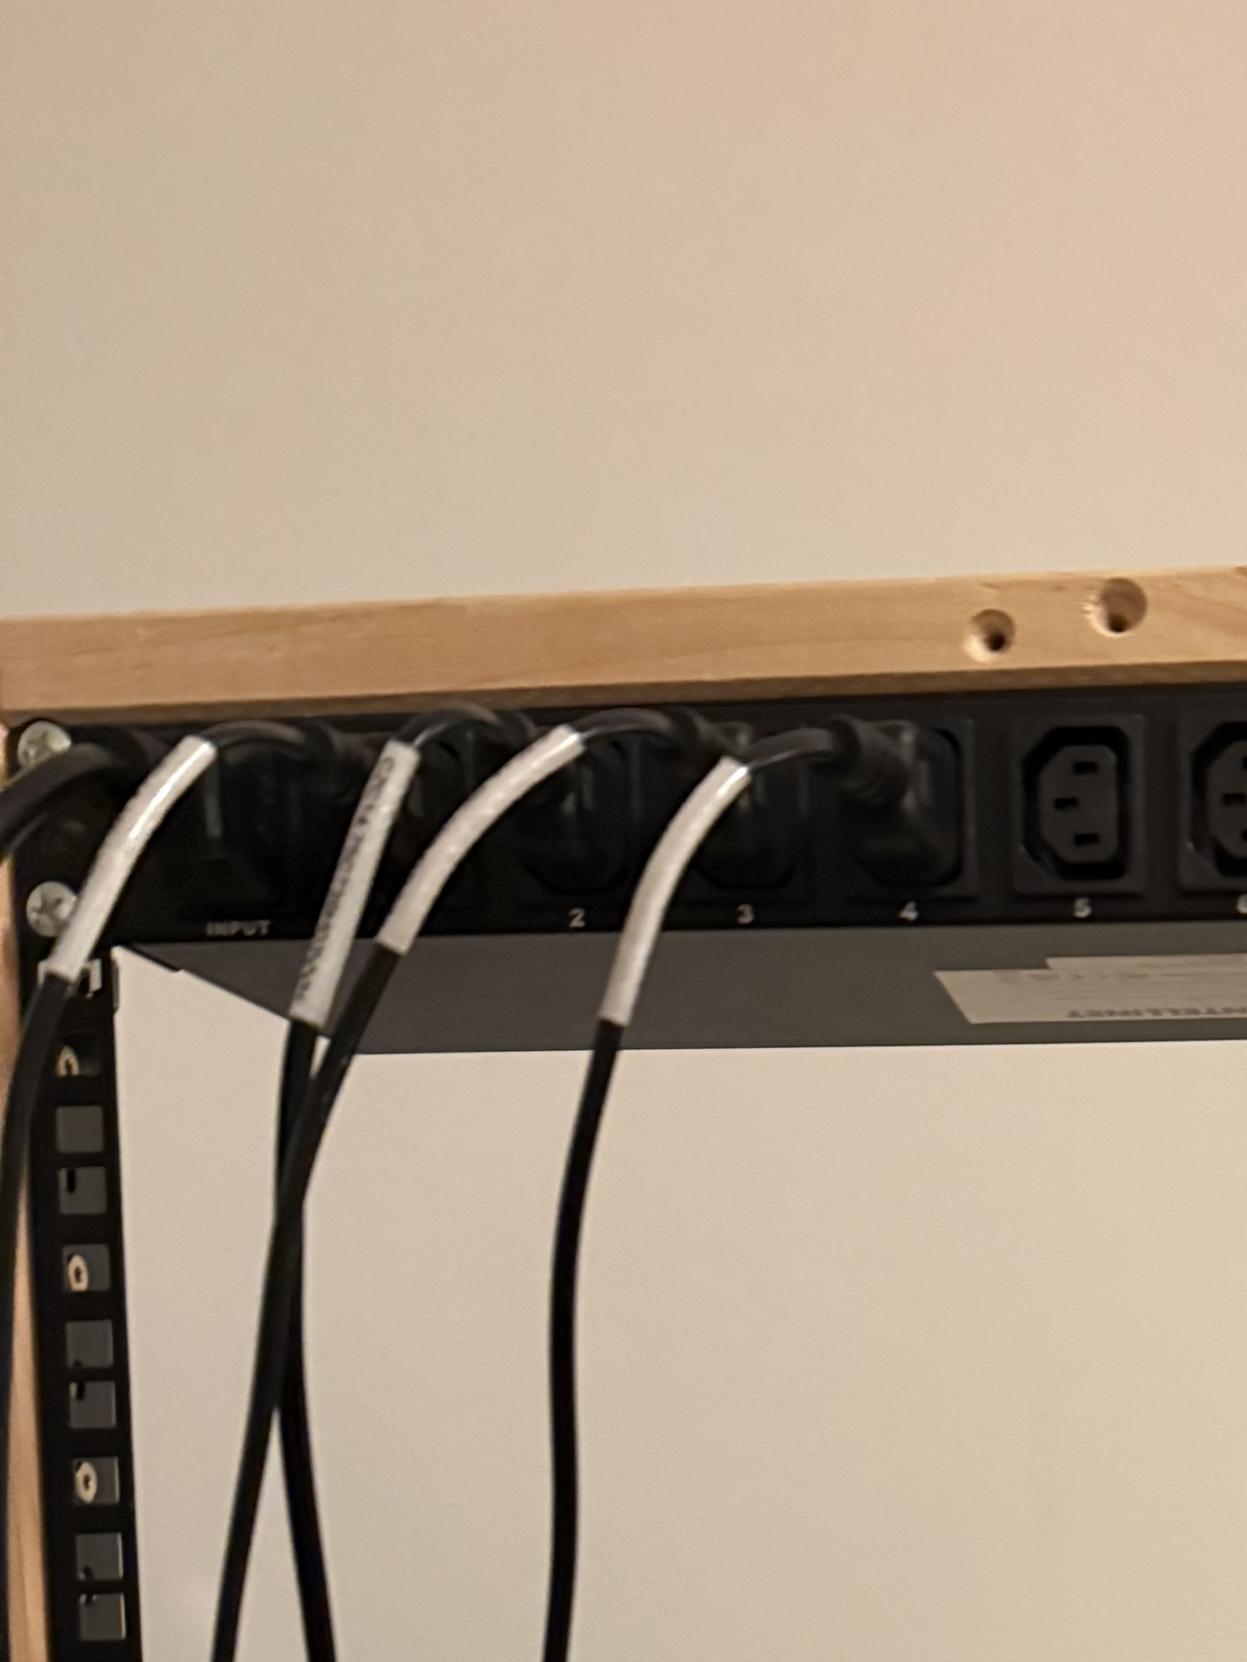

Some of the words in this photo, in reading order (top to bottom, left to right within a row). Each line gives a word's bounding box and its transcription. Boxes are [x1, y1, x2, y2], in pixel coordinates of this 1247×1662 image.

[569, 908, 587, 928] 2
[737, 903, 754, 924] 3
[899, 902, 918, 922] 4
[1073, 897, 1092, 918] 5
